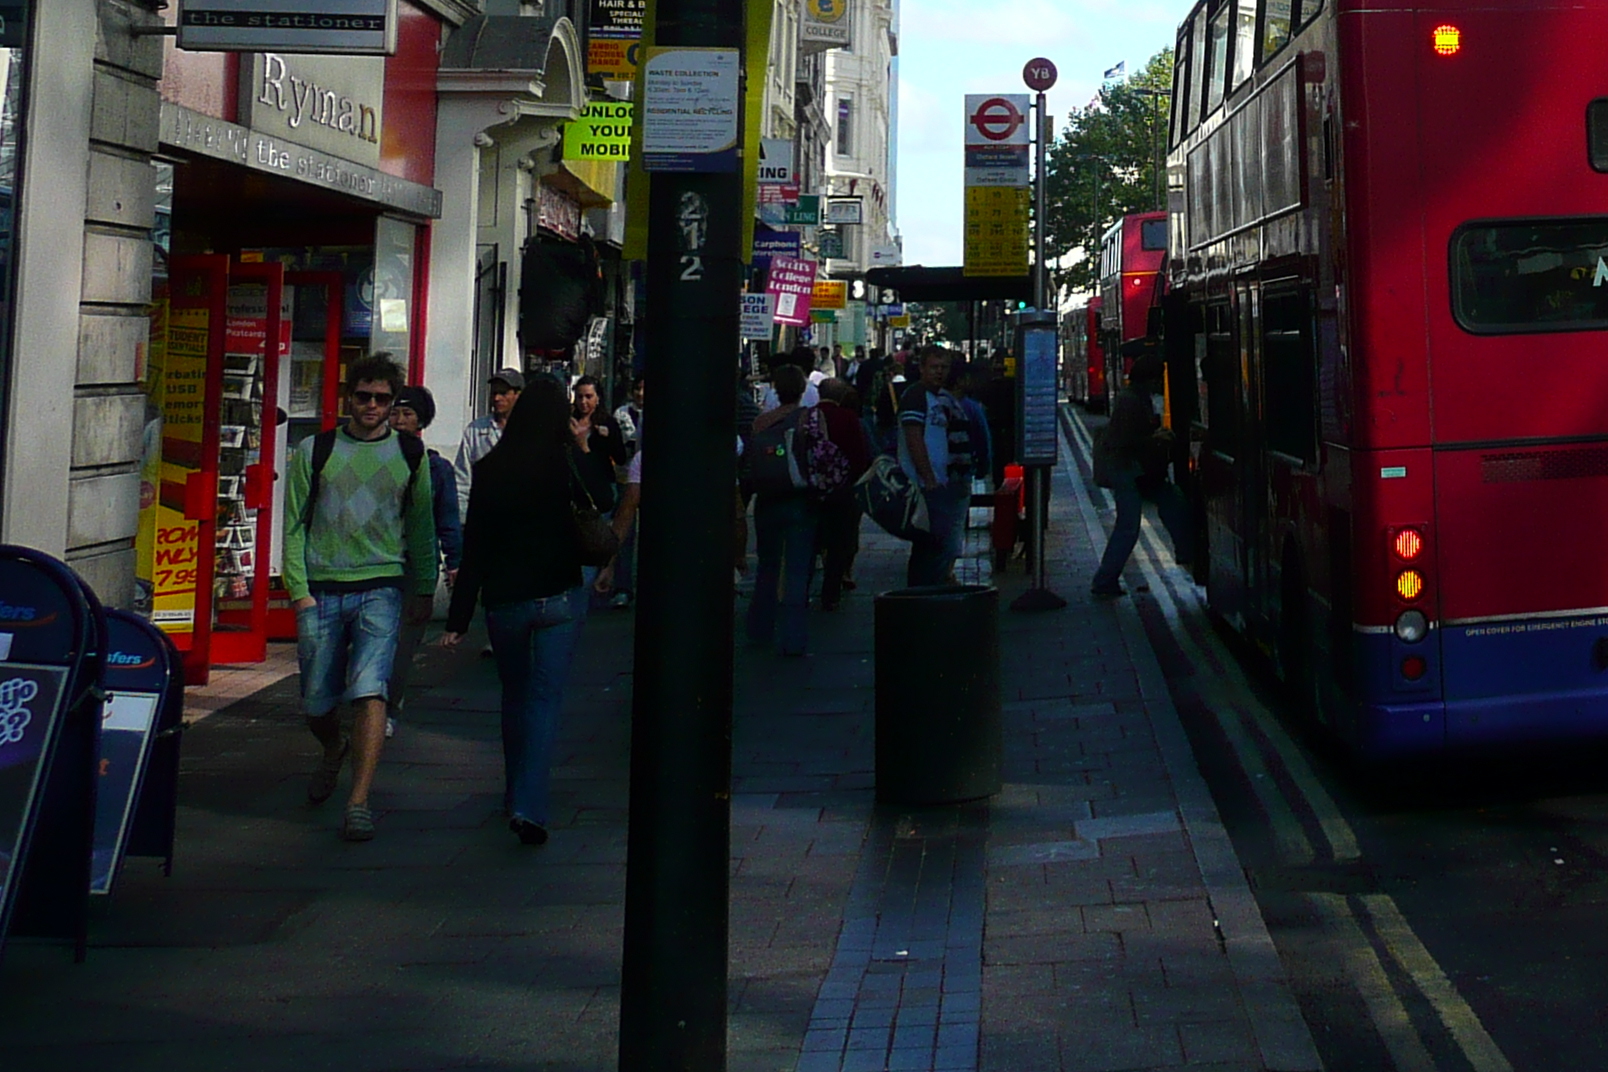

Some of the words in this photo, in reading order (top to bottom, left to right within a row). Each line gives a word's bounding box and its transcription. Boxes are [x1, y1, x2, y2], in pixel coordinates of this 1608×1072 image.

[599, 0, 624, 8] HAIR
[627, 0, 635, 8] &
[638, 0, 646, 8] B
[190, 12, 235, 25] the
[247, 14, 382, 29] stationer
[806, 27, 846, 38] COLLEGE
[1031, 68, 1050, 79] YB
[258, 52, 378, 144] Ryman
[581, 144, 630, 156] MOBI
[256, 139, 291, 169] the
[297, 155, 376, 196] stationer
[758, 167, 787, 179] ING
[755, 240, 797, 249] Carphone
[772, 269, 812, 284] College
[769, 280, 812, 294] London
[882, 289, 894, 304] 3
[226, 319, 257, 327] London
[168, 330, 206, 341] TUDENT
[225, 329, 266, 338] Postcards
[167, 342, 205, 353] SENTIALS
[166, 384, 197, 394] USB
[157, 525, 198, 545] ROM
[156, 546, 198, 566] NLY
[1465, 626, 1486, 637] OPEN
[1486, 625, 1511, 636] COVER
[1511, 624, 1526, 634] FOR
[1527, 620, 1569, 633] EMERGENCY
[1570, 618, 1597, 629] ENGINE
[1, 679, 35, 710] ijo
